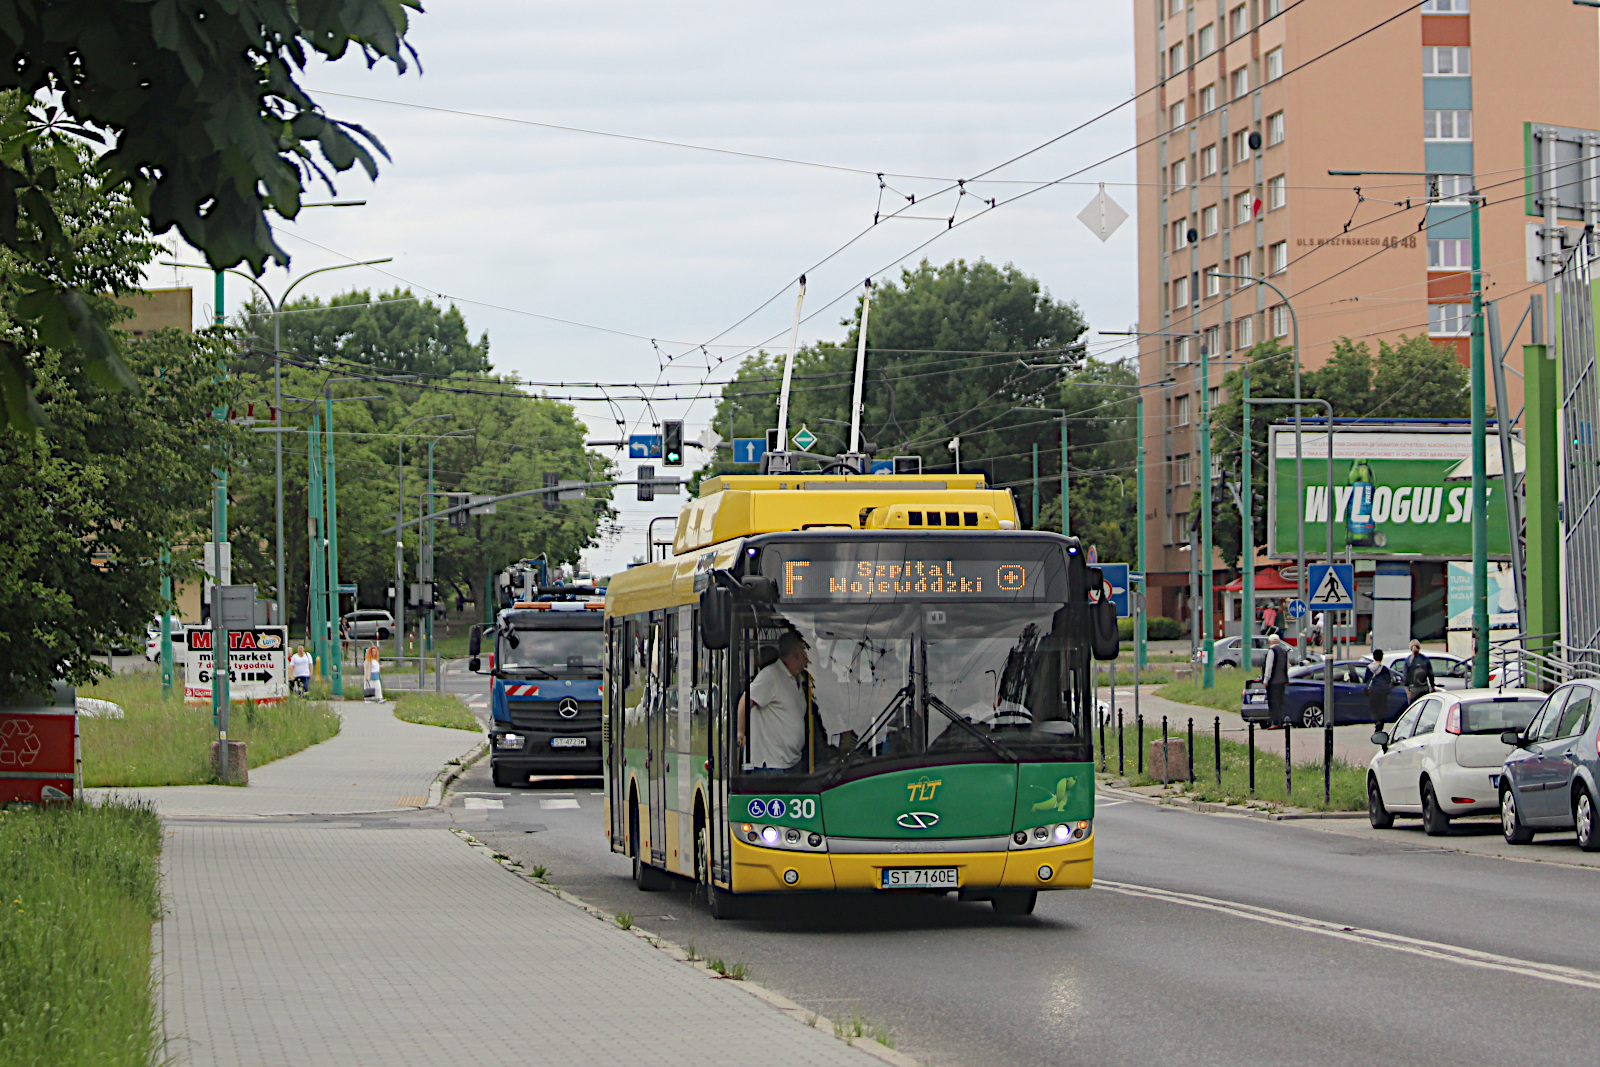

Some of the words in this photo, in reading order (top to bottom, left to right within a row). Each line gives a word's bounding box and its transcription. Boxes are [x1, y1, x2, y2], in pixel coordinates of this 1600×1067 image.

[1382, 236, 1398, 249] 46
[1400, 236, 1417, 249] 48
[1304, 486, 1444, 524] WYLOGUJ
[785, 560, 810, 594] F
[857, 560, 954, 578] Szpital
[829, 577, 982, 594] Wojewódzki
[192, 632, 256, 648] MTA
[907, 780, 942, 802] TLT
[789, 798, 815, 818] 30
[891, 871, 909, 884] ST
[915, 870, 955, 883] 7160E
